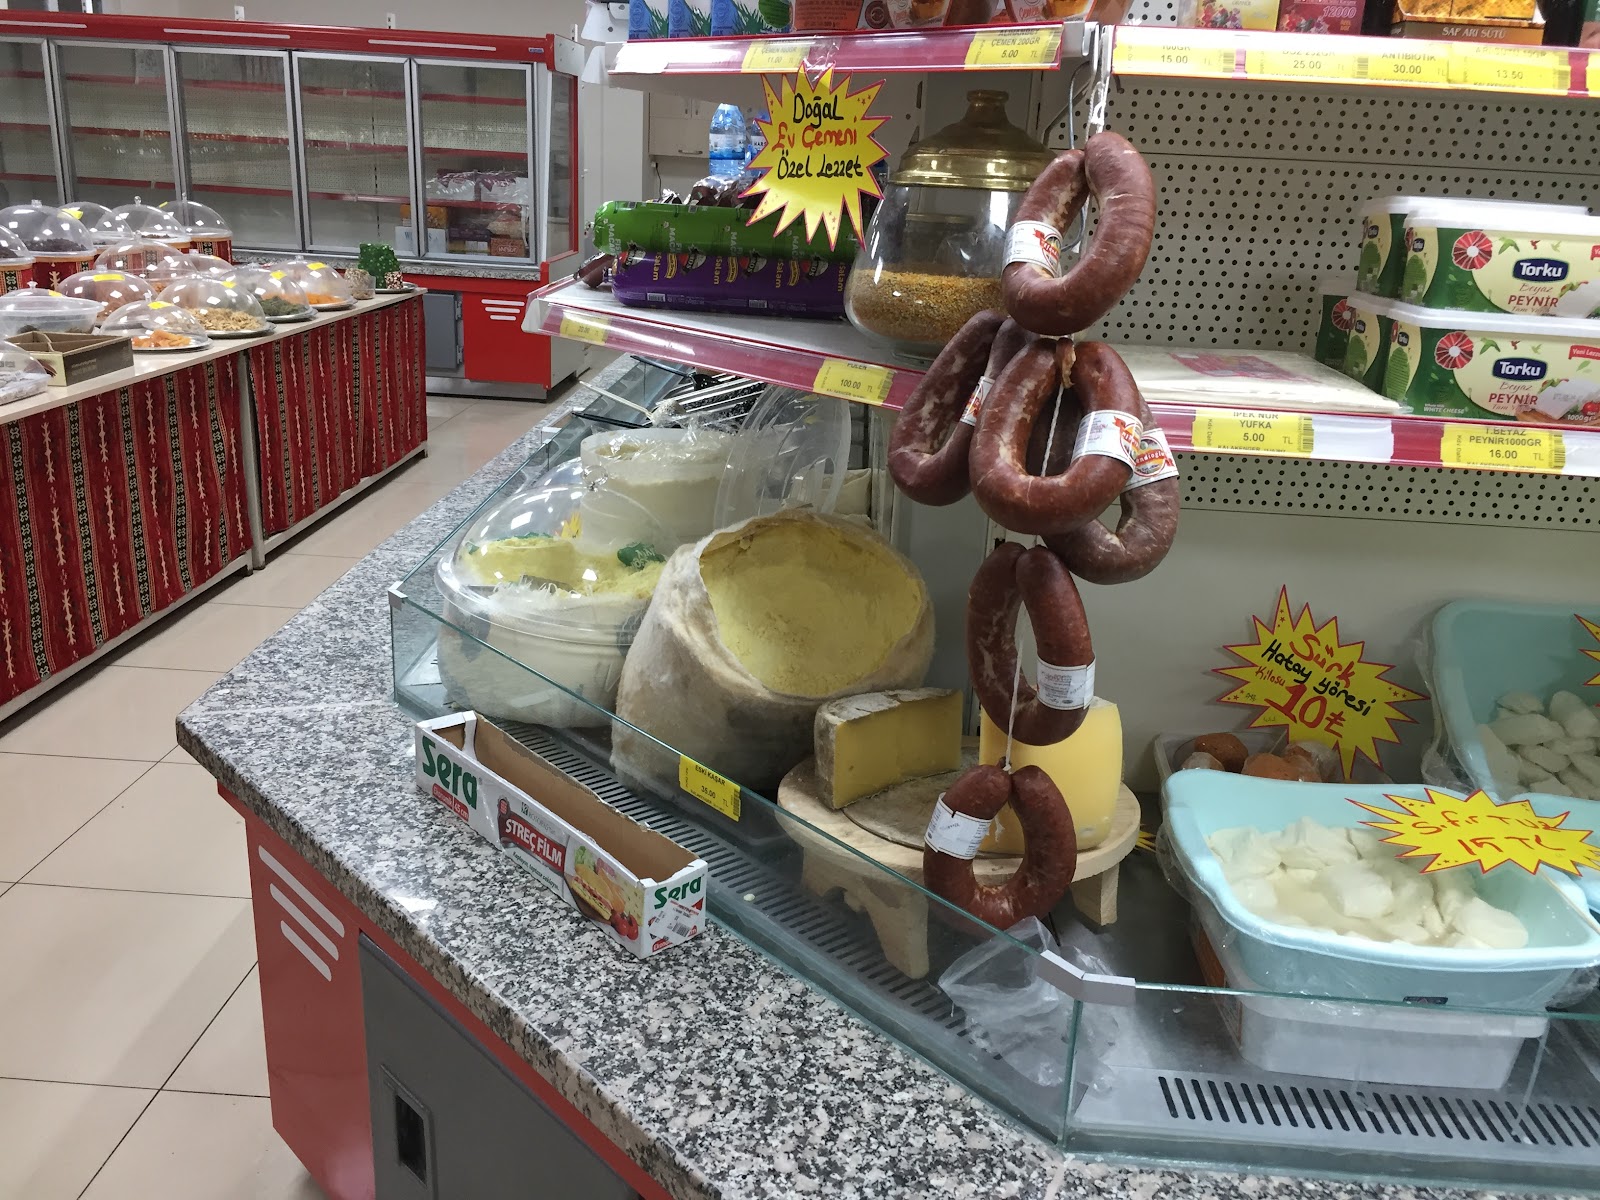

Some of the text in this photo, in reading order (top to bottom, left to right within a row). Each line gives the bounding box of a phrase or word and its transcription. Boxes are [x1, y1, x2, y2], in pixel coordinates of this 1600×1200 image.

[1323, 5, 1357, 19] 12000
[1442, 26, 1461, 37] SAF
[991, 38, 1019, 48] ÇEMEN
[1000, 49, 1019, 59] 5.00
[1160, 54, 1189, 64] 15.00
[1292, 60, 1322, 70] 25.00
[1393, 64, 1422, 75] 30.00
[1496, 69, 1524, 80] 13.50
[792, 92, 844, 129] Doğal
[777, 149, 813, 180] Özel
[1519, 262, 1563, 278] Torku
[1507, 294, 1559, 308] PEYNİR
[1499, 361, 1541, 377] Torku
[840, 378, 862, 390] 100.00
[1488, 393, 1539, 406] PEYNİR
[1239, 419, 1272, 429] YUFKA
[1243, 432, 1294, 445] 5.00 TL
[1489, 449, 1544, 461] 16.00 TL
[1288, 633, 1356, 689] Sürk
[1260, 638, 1377, 717] Hatay yöresi
[421, 735, 478, 810] Sera
[707, 771, 726, 787] KAŞAR
[700, 785, 717, 799] 35.00
[505, 818, 537, 853] STREÇ
[536, 837, 563, 867] FİLM
[1457, 834, 1567, 856] 15 TL
[653, 876, 702, 910] Sera
